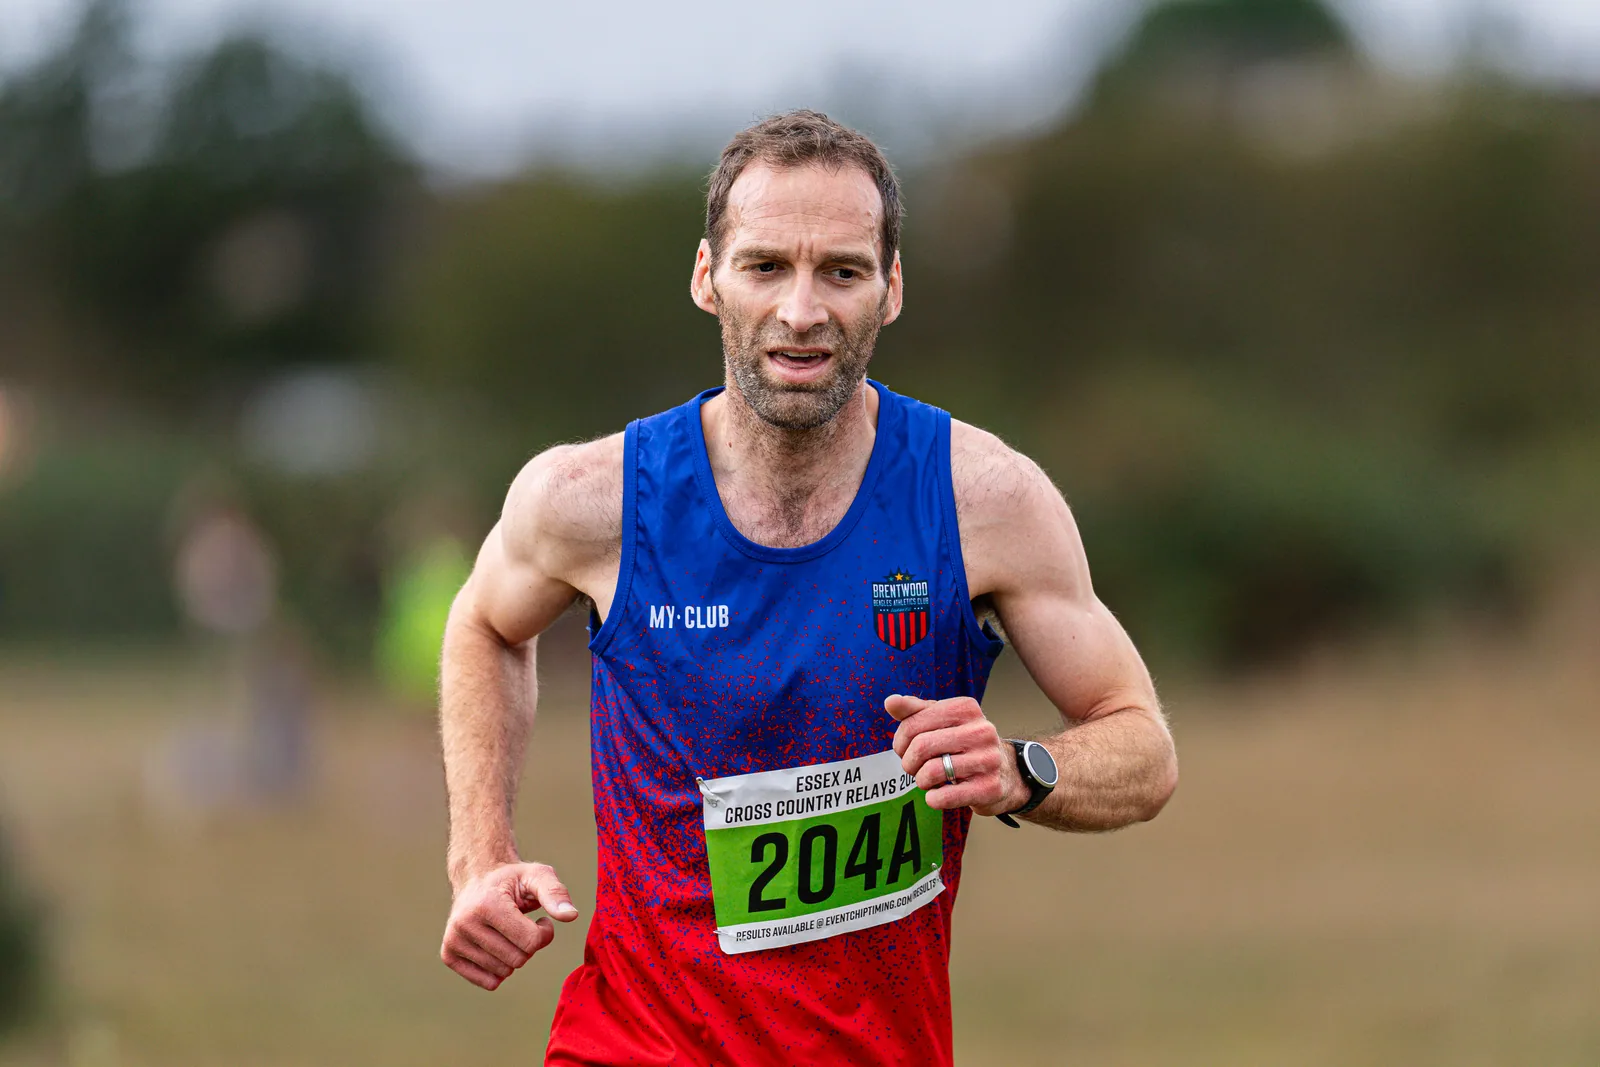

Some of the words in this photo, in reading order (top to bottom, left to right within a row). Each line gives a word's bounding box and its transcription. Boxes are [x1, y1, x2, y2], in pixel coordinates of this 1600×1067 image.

[873, 582, 928, 598] BRENTWOOD
[796, 771, 840, 793] ESSEX
[844, 767, 862, 784] AA
[725, 804, 772, 824] CROSS
[776, 791, 842, 817] COUNTRY
[846, 778, 896, 805] RELAYS
[748, 800, 922, 913] 204A
[736, 927, 771, 942] RESULTS
[772, 920, 815, 937] AVAILABLE
[816, 918, 825, 929] @
